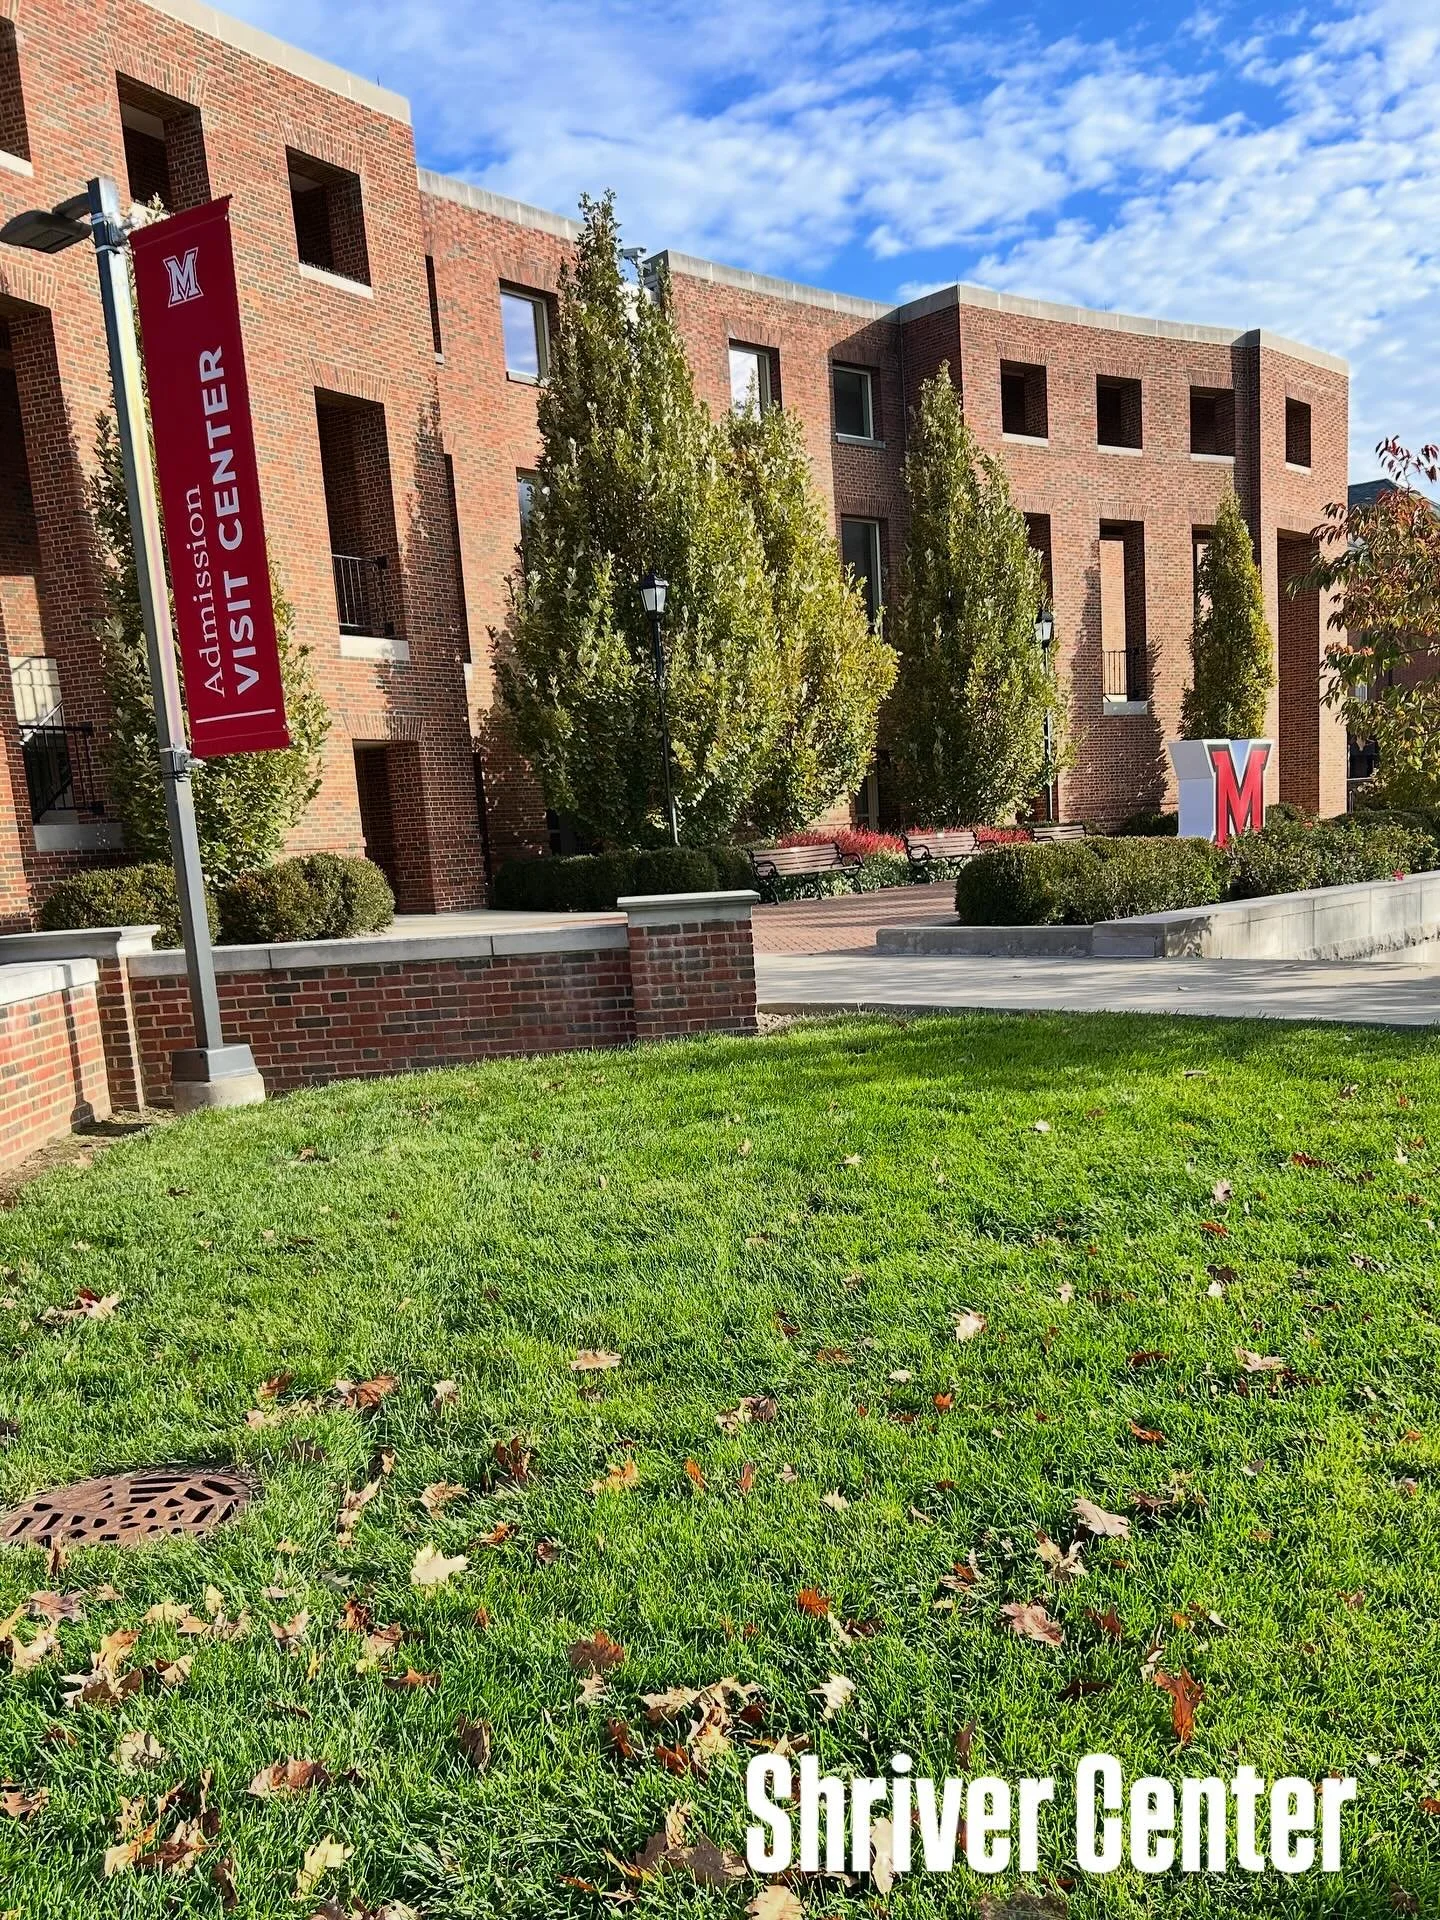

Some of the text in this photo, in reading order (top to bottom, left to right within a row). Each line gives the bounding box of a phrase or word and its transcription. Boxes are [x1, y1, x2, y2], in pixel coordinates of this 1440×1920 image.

[162, 247, 204, 308] M
[181, 484, 225, 697] Admission
[198, 346, 260, 695] VISIT CENTER
[1204, 739, 1274, 849] M
